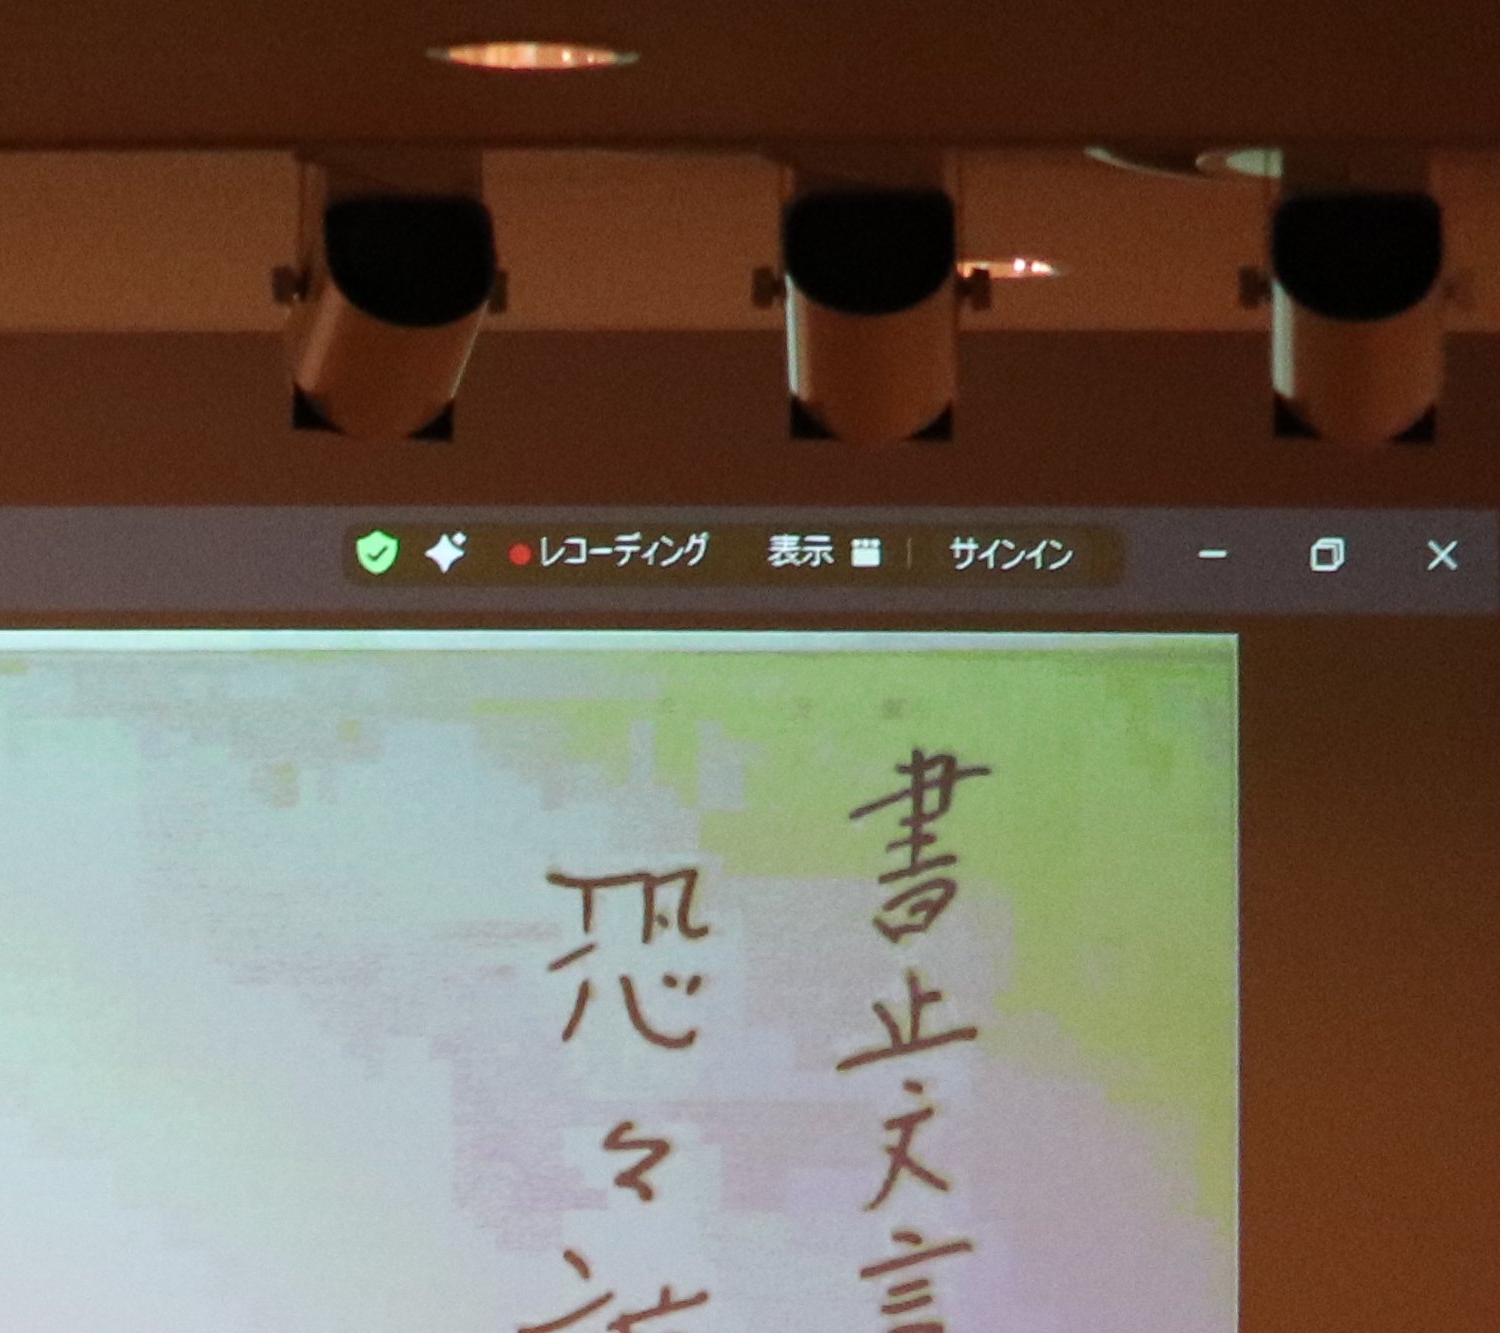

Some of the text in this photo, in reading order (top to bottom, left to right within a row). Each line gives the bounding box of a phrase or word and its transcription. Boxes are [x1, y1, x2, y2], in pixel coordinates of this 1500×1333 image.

[539, 531, 710, 568] レコーディング
[768, 534, 834, 568] 表示
[949, 537, 1075, 570] サインイン
